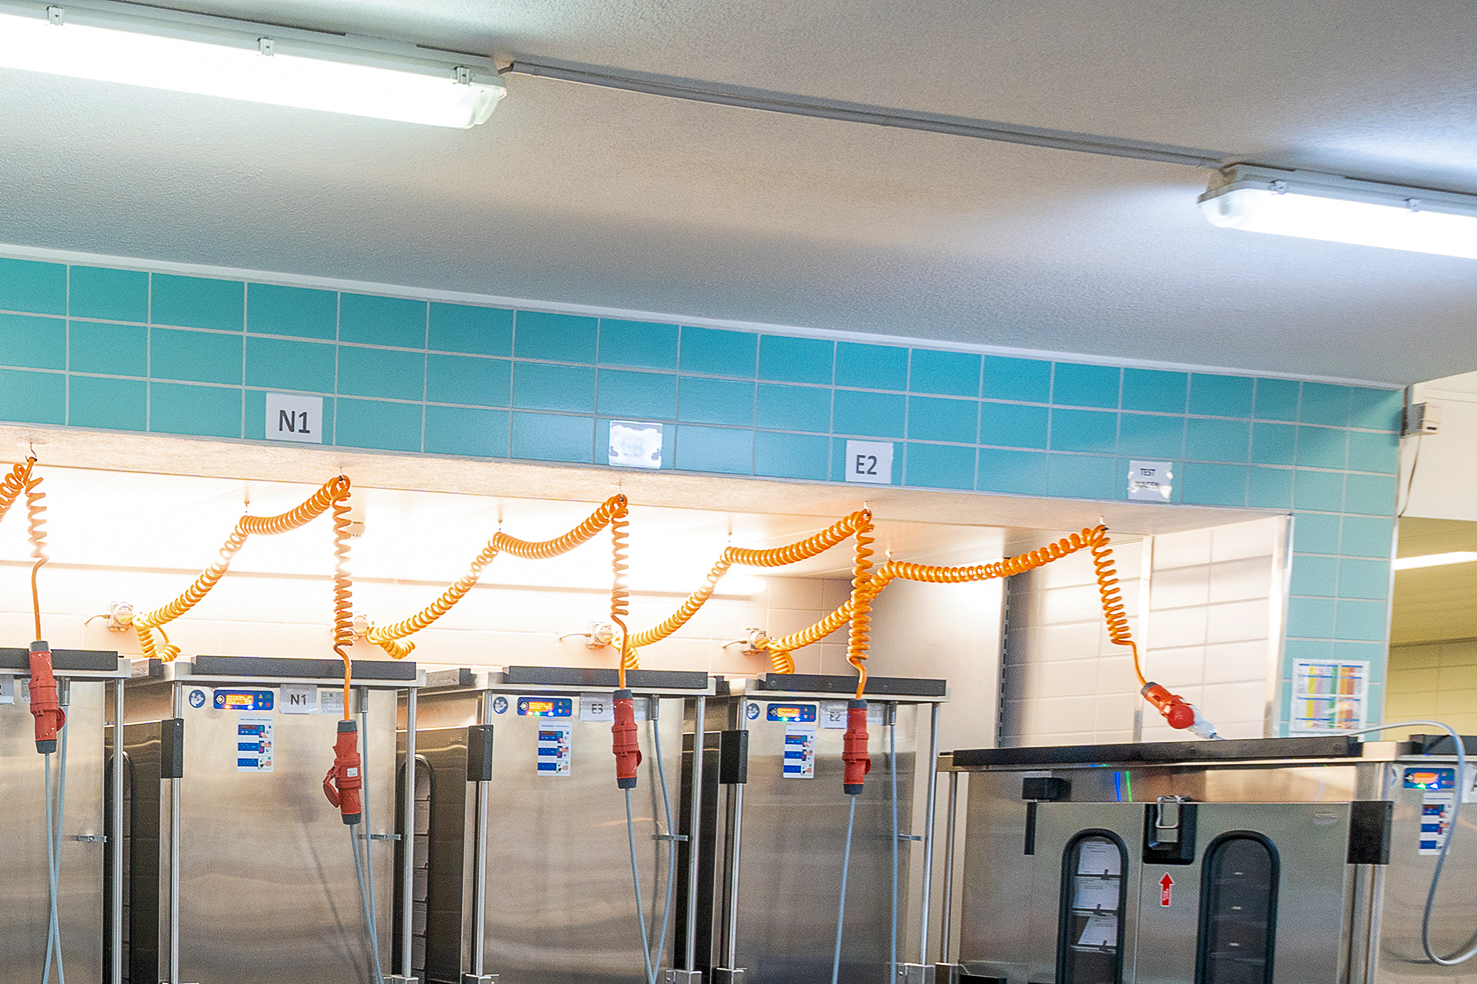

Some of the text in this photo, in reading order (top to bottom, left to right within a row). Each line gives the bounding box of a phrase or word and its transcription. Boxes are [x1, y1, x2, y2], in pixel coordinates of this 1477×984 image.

[279, 409, 311, 434] N1
[856, 454, 878, 475] E2
[1140, 468, 1156, 477] TEST
[290, 694, 307, 706] N1
[591, 703, 604, 715] E3
